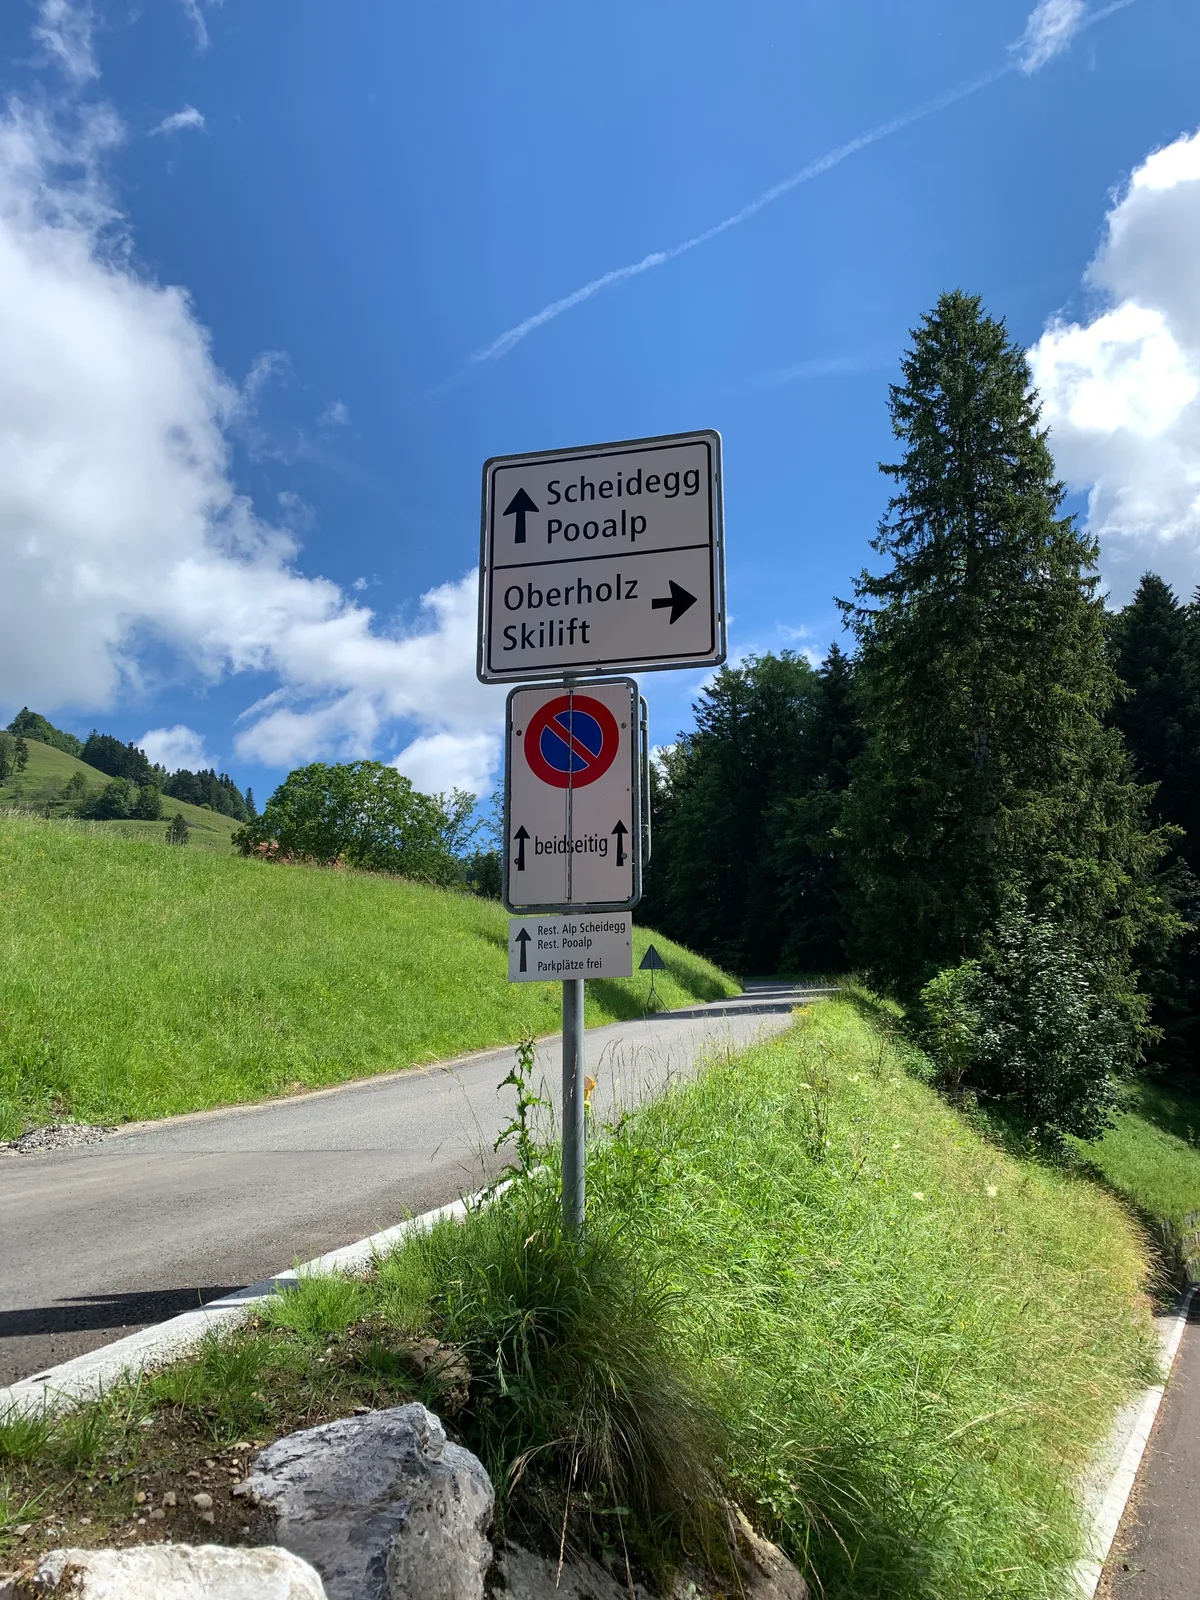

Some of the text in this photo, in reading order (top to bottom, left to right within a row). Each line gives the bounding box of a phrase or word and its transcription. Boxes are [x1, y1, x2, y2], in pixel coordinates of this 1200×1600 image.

[547, 468, 700, 505] Scheidegg
[547, 509, 647, 544] Pooalp
[504, 574, 638, 610] Oberholz
[503, 617, 590, 651] Skilift
[538, 921, 626, 936] Rest. Alp Scheidegg
[538, 936, 593, 949] Rest. Pooalp
[538, 958, 602, 973] Parkplätze frei
